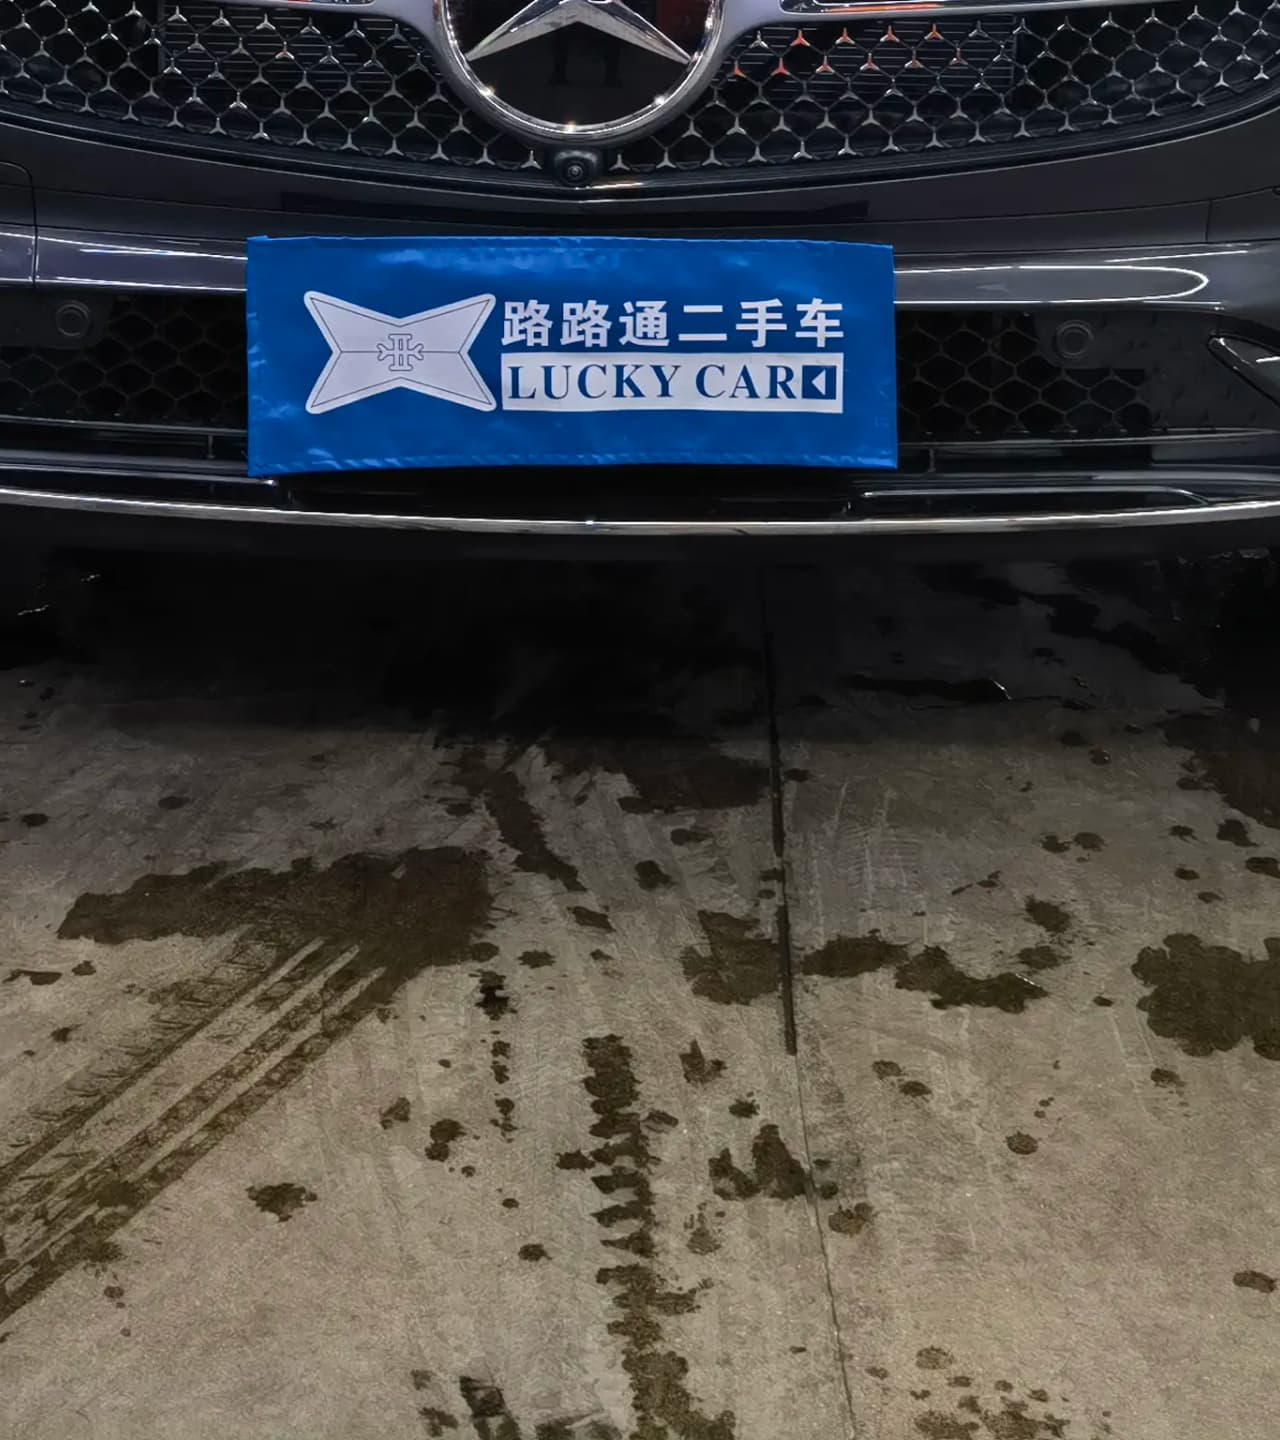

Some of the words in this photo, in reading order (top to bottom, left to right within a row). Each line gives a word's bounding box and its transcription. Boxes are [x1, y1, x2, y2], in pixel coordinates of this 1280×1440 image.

[501, 298, 845, 348] 路路通二手车
[508, 363, 681, 401] LUCKY
[695, 364, 797, 402] CAR
